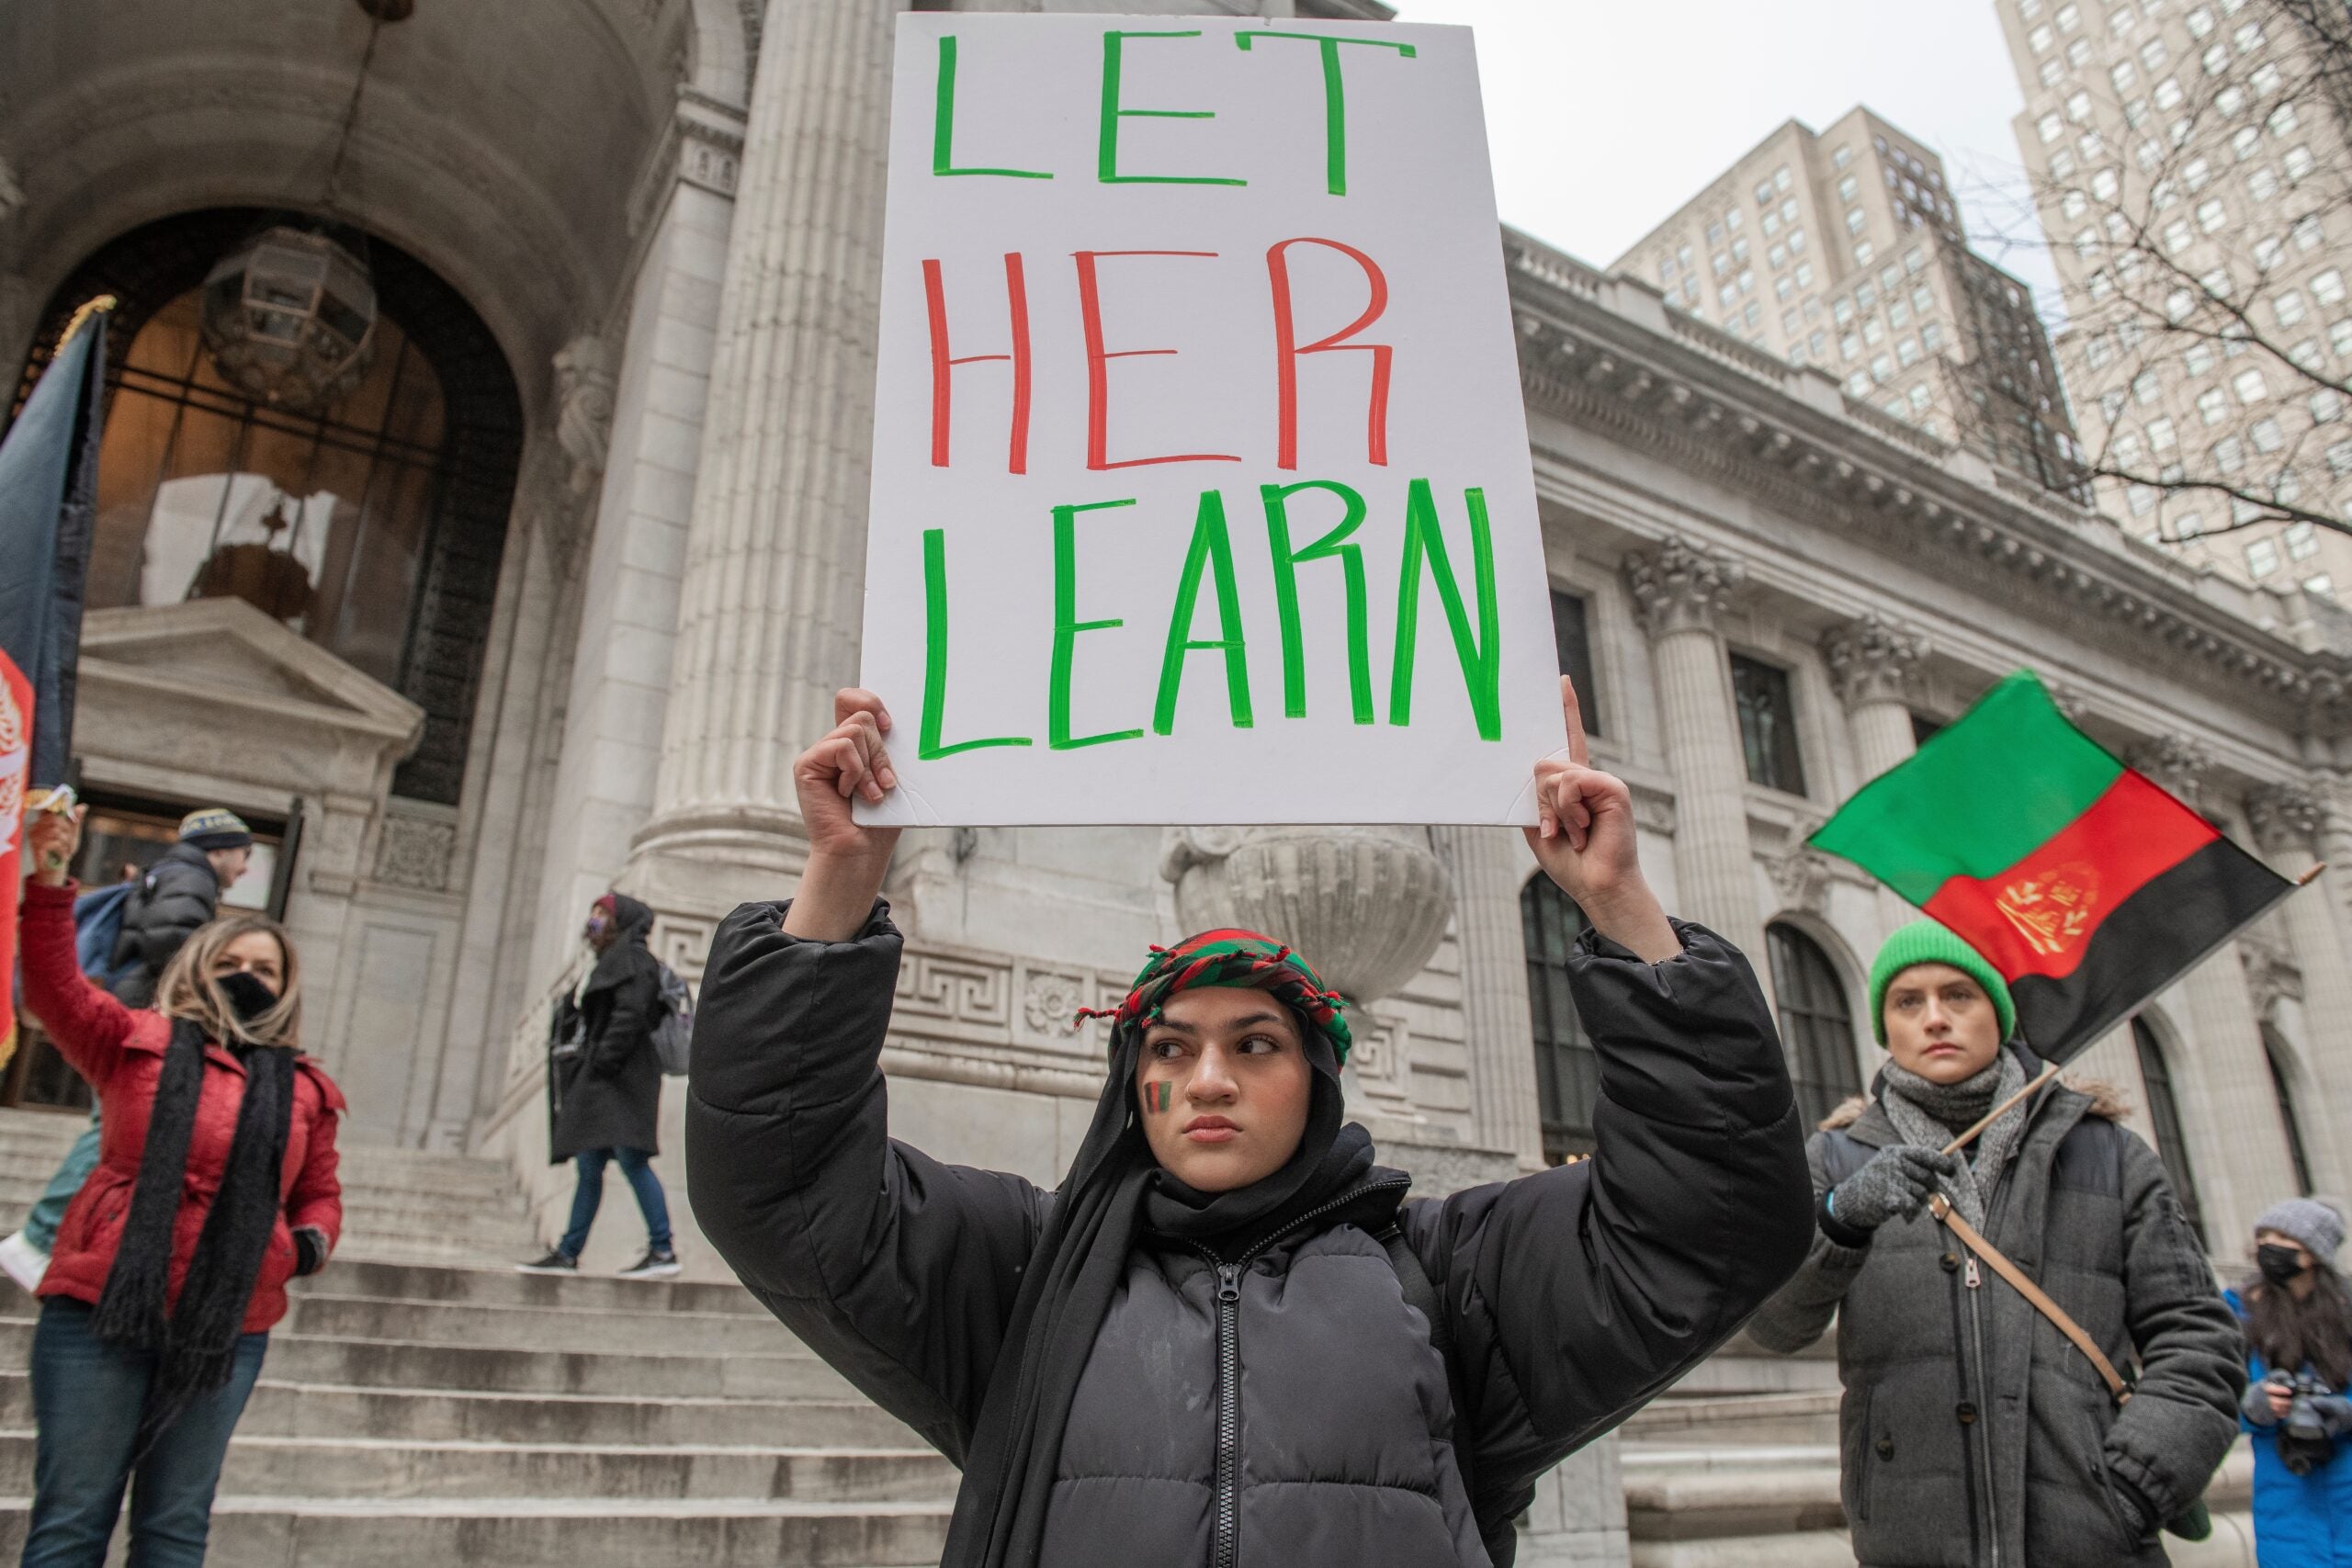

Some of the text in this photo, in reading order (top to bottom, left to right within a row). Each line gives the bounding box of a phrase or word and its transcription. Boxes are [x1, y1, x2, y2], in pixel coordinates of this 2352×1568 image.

[933, 31, 1416, 197] LET
[922, 237, 1393, 475] HER
[918, 478, 1502, 761] LEARN
